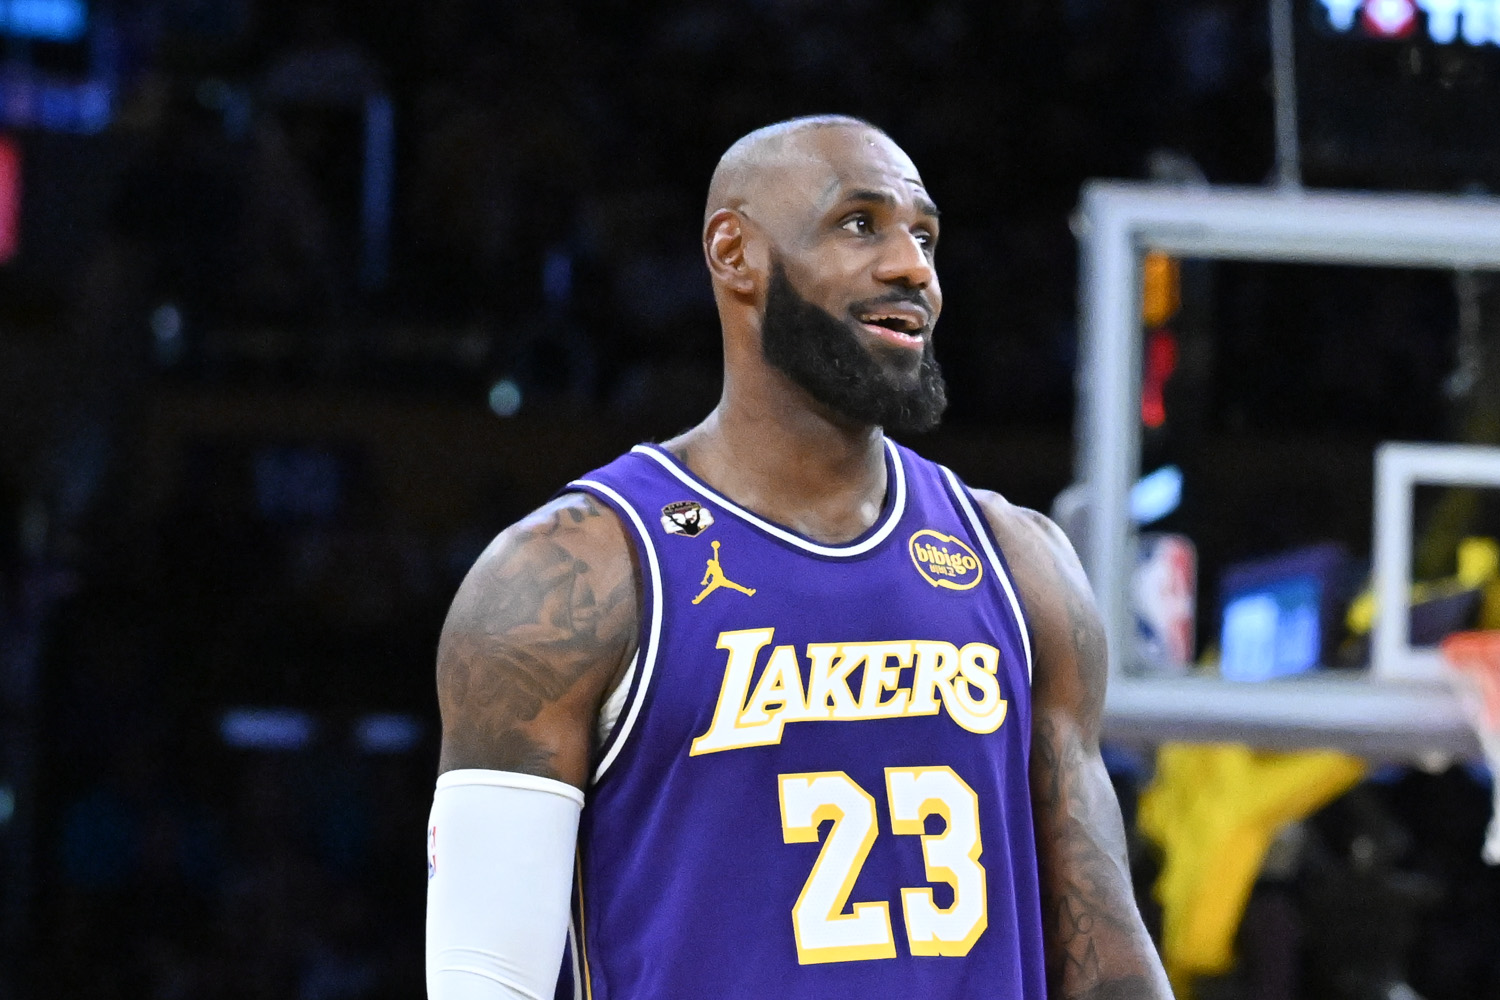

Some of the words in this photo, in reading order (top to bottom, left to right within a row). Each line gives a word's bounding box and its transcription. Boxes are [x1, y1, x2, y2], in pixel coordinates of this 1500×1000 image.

[914, 543, 977, 575] bibigo
[689, 627, 1008, 757] LAKERS
[777, 765, 989, 966] 23
